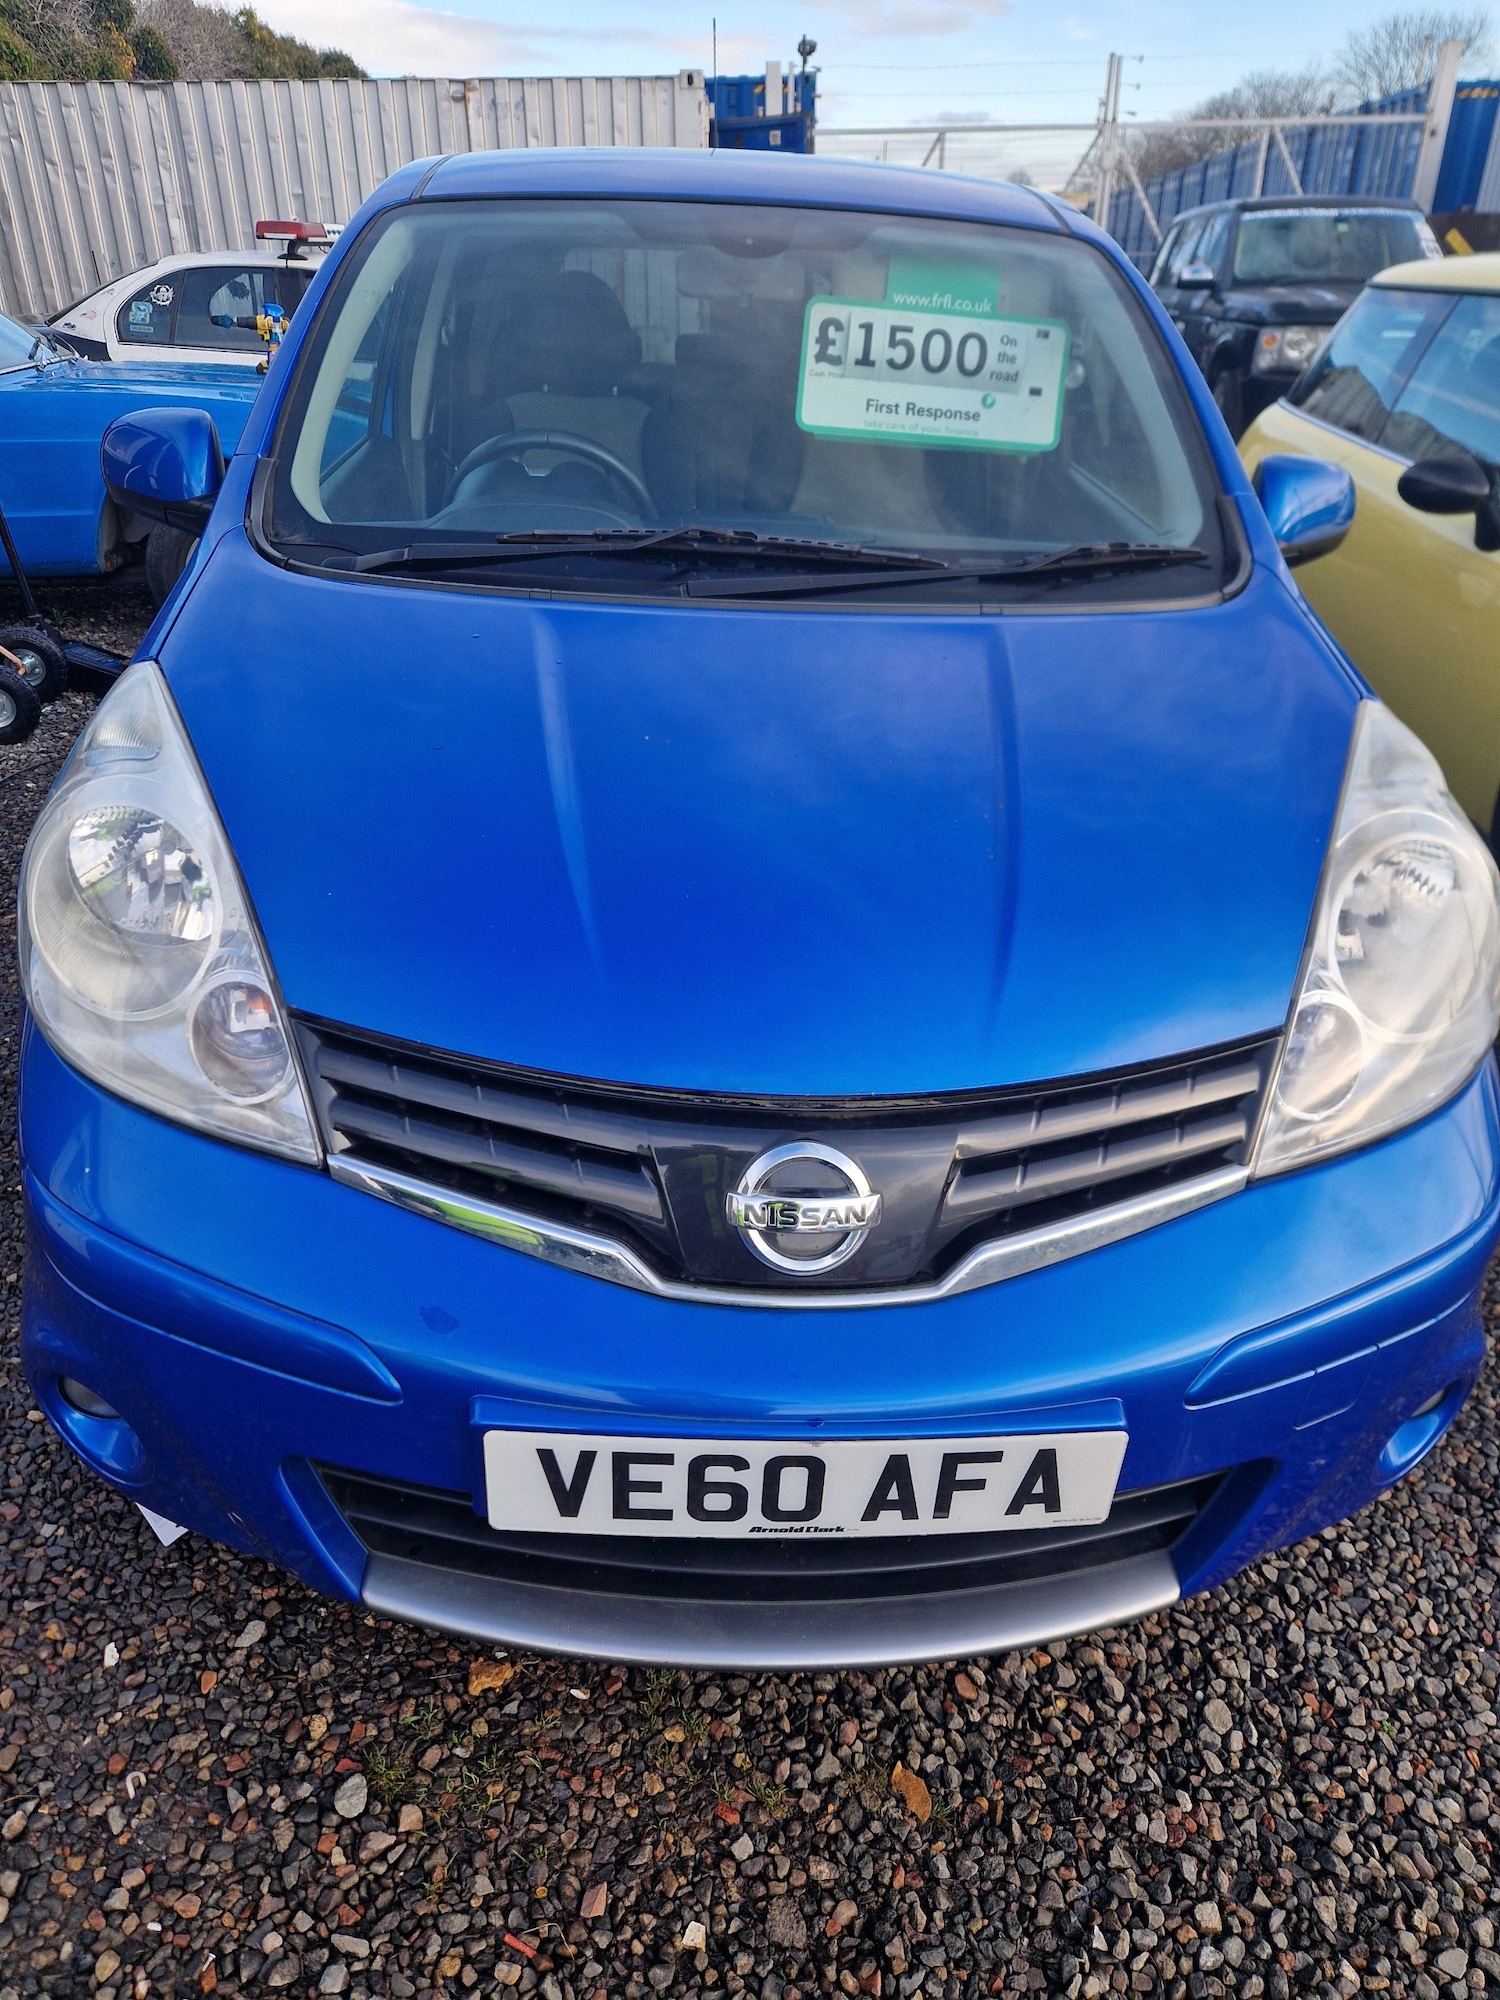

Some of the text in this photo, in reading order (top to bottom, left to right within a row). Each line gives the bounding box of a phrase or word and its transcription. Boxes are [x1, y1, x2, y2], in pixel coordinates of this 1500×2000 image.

[814, 317, 988, 377] £1500
[1000, 334, 1018, 348] On
[997, 350, 1017, 365] the
[989, 370, 1019, 383] road
[865, 399, 982, 422] First Response
[743, 1202, 867, 1228] NISSAN
[536, 1448, 1062, 1522] VE60 AFA
